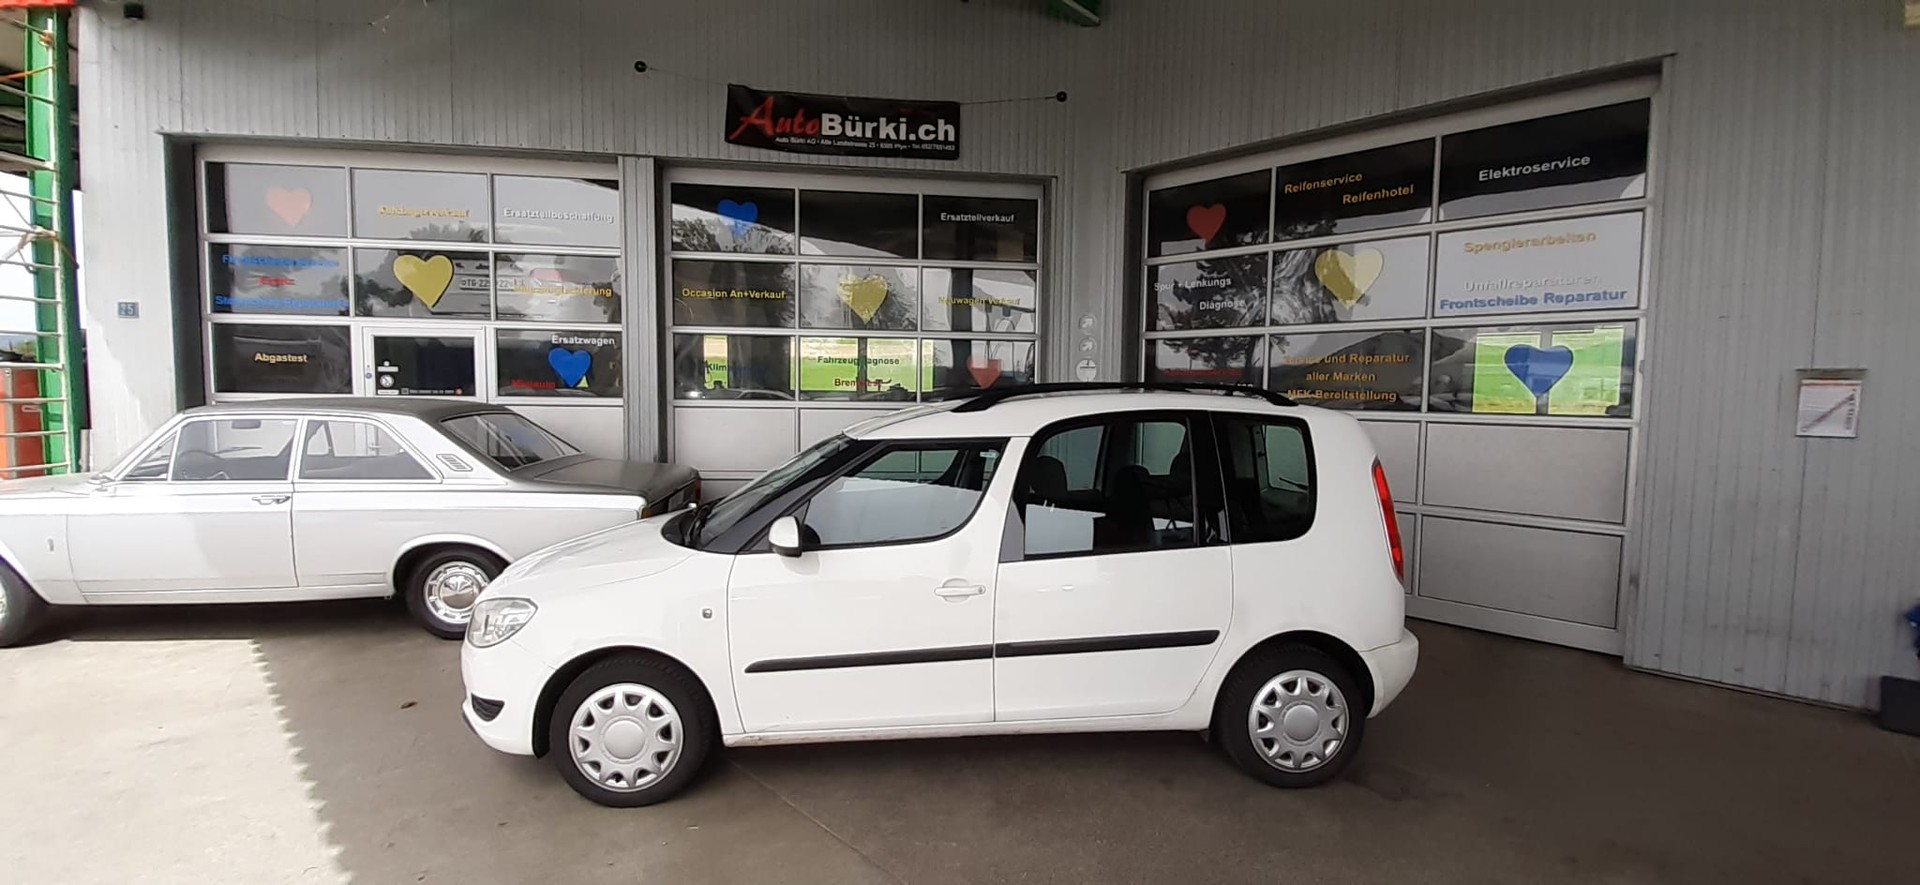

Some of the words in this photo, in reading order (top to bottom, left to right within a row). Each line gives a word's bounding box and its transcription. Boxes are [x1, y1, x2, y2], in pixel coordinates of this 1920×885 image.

[1478, 155, 1591, 182] Elektroservice
[1284, 172, 1363, 194] Reifenservice
[1342, 183, 1415, 205] Reifenhotel
[503, 207, 615, 224] Ersatzteilbeschaffung
[940, 212, 1015, 223] Ersatzteilverkauf
[1464, 232, 1596, 254] Spenglerarbeiten
[1154, 281, 1175, 292] Spur
[1184, 278, 1232, 289] Lenkungs
[682, 287, 728, 298] Occasion
[729, 289, 785, 300] An+Verkauf
[1439, 294, 1538, 310] Frontscheibe
[1543, 289, 1628, 306] Reparatur
[938, 296, 986, 306] Neuwagen
[1199, 299, 1246, 311] Diagnose
[551, 334, 616, 347] Ersatzwagen
[254, 352, 308, 364] Abgastest
[1324, 354, 1346, 364] und
[1350, 353, 1410, 365] Reparatur
[1306, 371, 1330, 381] aller
[1332, 371, 1376, 382] Marken
